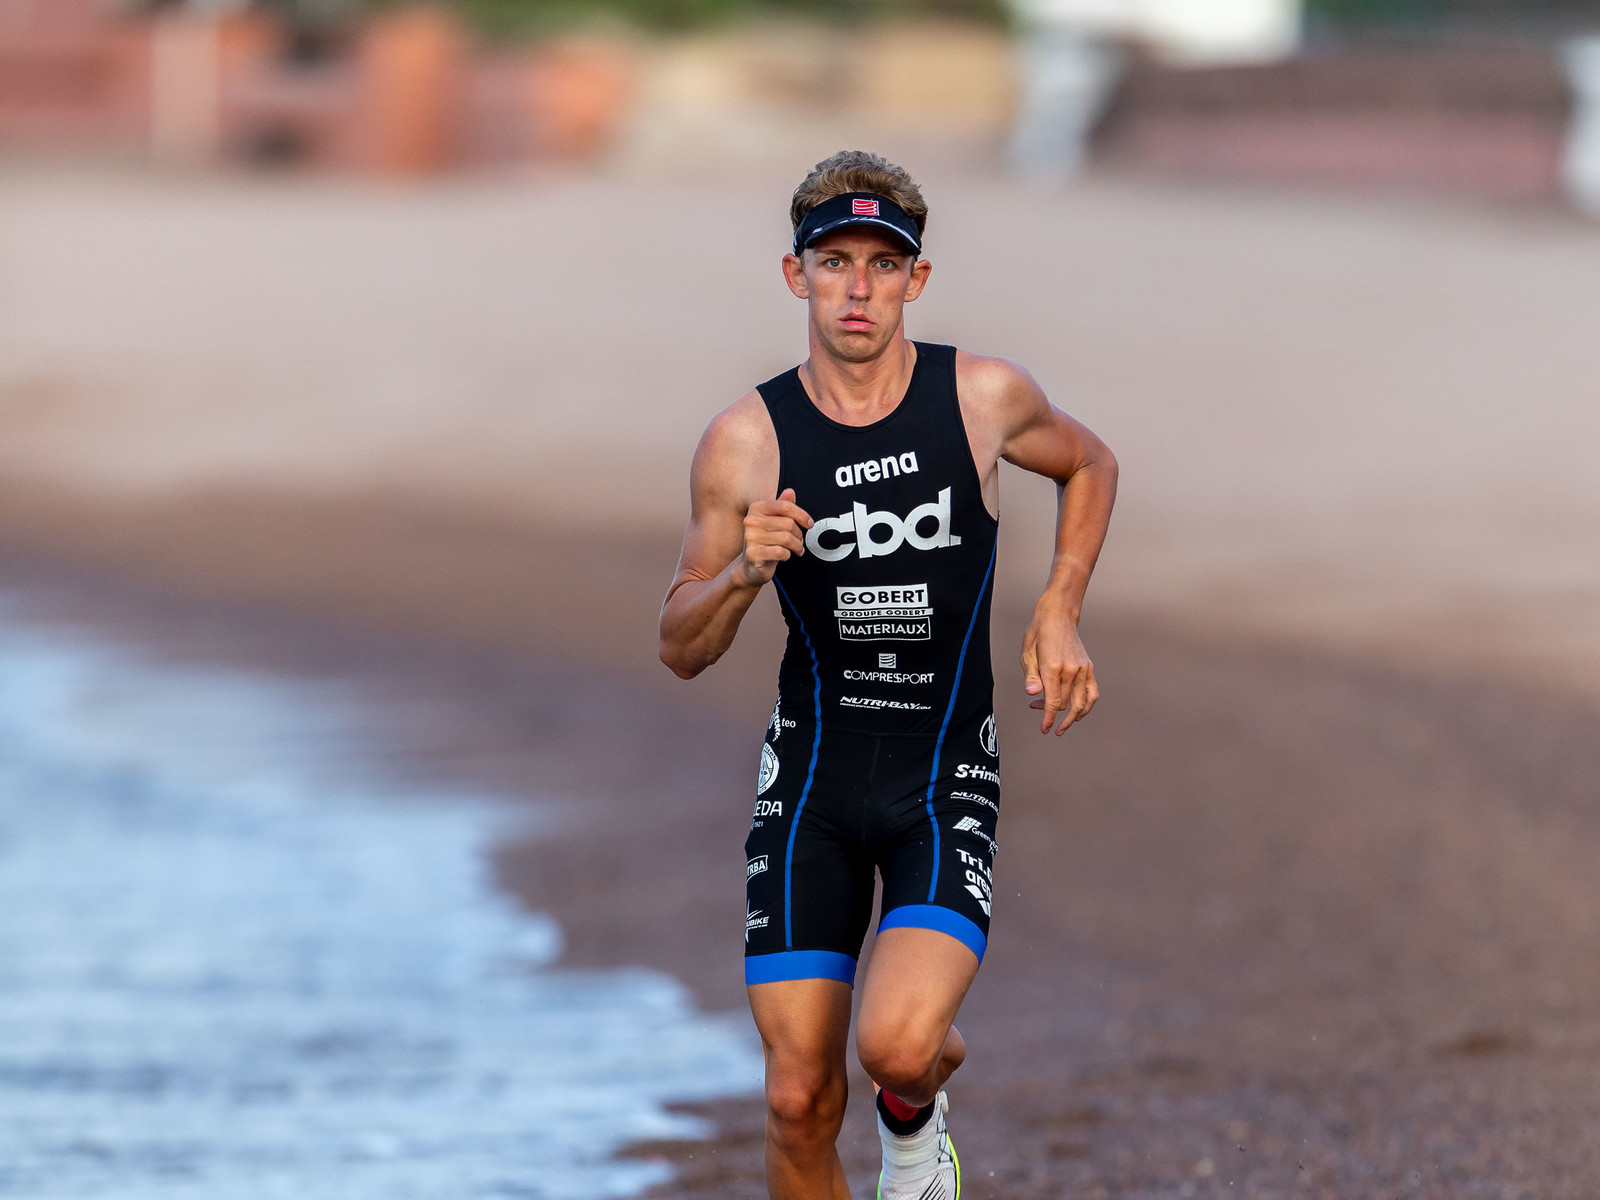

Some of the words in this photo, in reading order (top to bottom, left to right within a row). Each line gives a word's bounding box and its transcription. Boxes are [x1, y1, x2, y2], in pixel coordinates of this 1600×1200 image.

[835, 451, 919, 488] arena
[840, 589, 925, 605] GOBERT
[841, 623, 927, 635] MATERIAUX
[843, 669, 935, 684] COMPRESSPORT
